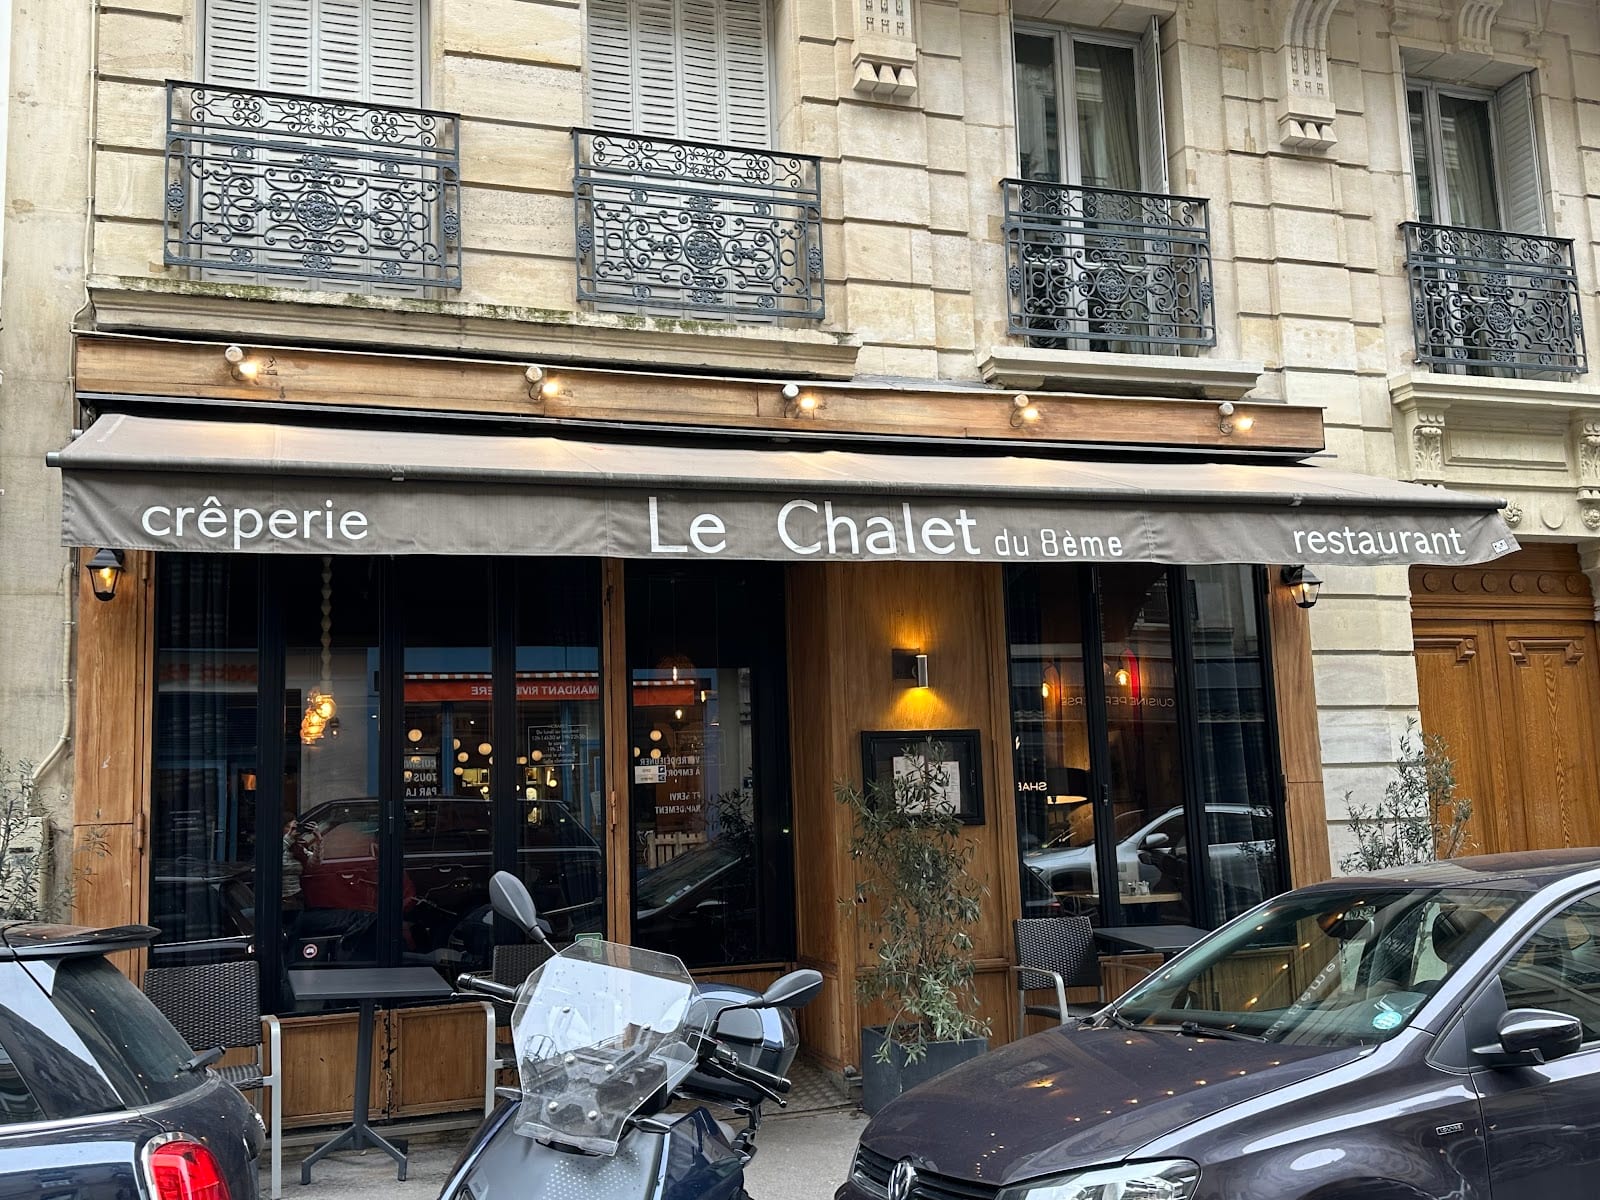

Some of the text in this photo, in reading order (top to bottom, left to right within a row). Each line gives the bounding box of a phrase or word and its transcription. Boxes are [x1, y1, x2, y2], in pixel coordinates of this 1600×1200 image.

[142, 496, 368, 550] crêperie
[649, 496, 1123, 557] Le Chalet du 8ème
[1293, 526, 1466, 555] restaurant
